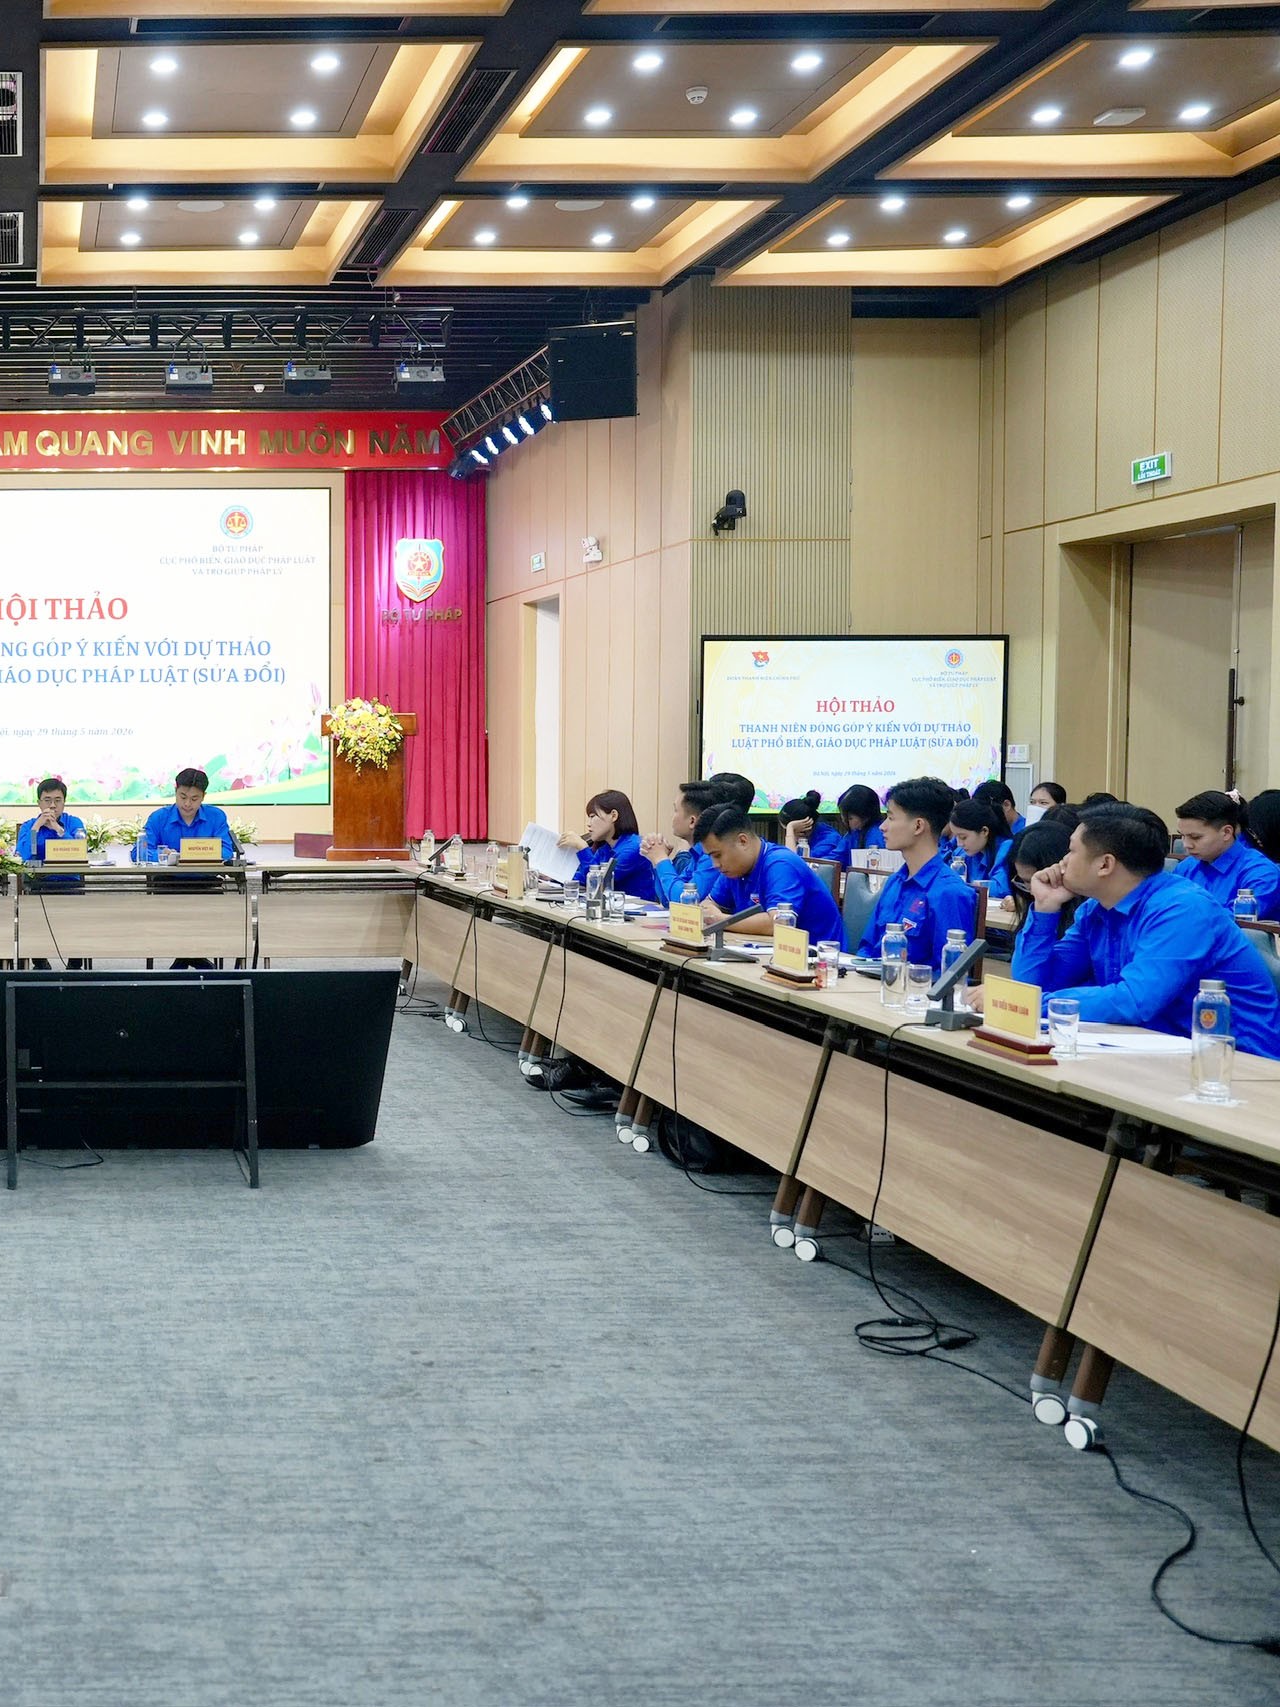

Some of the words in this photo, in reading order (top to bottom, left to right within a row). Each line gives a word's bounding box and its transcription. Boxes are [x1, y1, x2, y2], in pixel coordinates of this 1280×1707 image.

[35, 430, 153, 456] QUANG
[168, 429, 246, 455] VINH
[259, 423, 355, 455] MUÔN
[369, 423, 440, 455] NĂM
[1140, 459, 1158, 471] EXIT
[45, 591, 128, 620] THẢO
[381, 608, 401, 624] BỘ
[403, 608, 422, 621] TƯ
[426, 606, 463, 621] PHÁP
[33, 637, 72, 657] GÓP
[76, 638, 89, 657] Ý
[93, 634, 140, 657] KIẾN
[144, 637, 178, 657] VỚI
[183, 640, 213, 660] DỰ
[216, 636, 272, 657] THẢO
[37, 668, 77, 688] DỤC
[82, 665, 135, 684] PHÁP
[140, 664, 189, 687] LUẬT
[193, 664, 239, 686] (SỬA
[245, 661, 286, 685] ĐỔI)
[816, 696, 846, 716] HỘI
[850, 696, 895, 713] THẢO
[13, 727, 35, 738] ngày
[37, 727, 49, 738] 29
[51, 727, 78, 738] tháng
[80, 727, 86, 738] 5
[88, 727, 109, 738] năm
[111, 727, 134, 738] 2026
[740, 724, 778, 733] THANH
[780, 722, 807, 733] NIÊN
[810, 722, 840, 733] ĐÓNG
[842, 722, 864, 733] GÓP
[875, 720, 900, 733] KIẾN
[903, 722, 921, 733] VỚI
[924, 723, 939, 735] DỰ
[941, 721, 971, 733] THẢO
[732, 737, 759, 750] LUẬT
[761, 735, 784, 748] PHỔ
[786, 735, 814, 749] BIẾN,
[816, 737, 842, 748] GIÁO
[845, 738, 867, 750] DỤC
[869, 736, 898, 748] PHÁP
[900, 736, 926, 750] LUẬT
[956, 735, 979, 748] ĐỔI)
